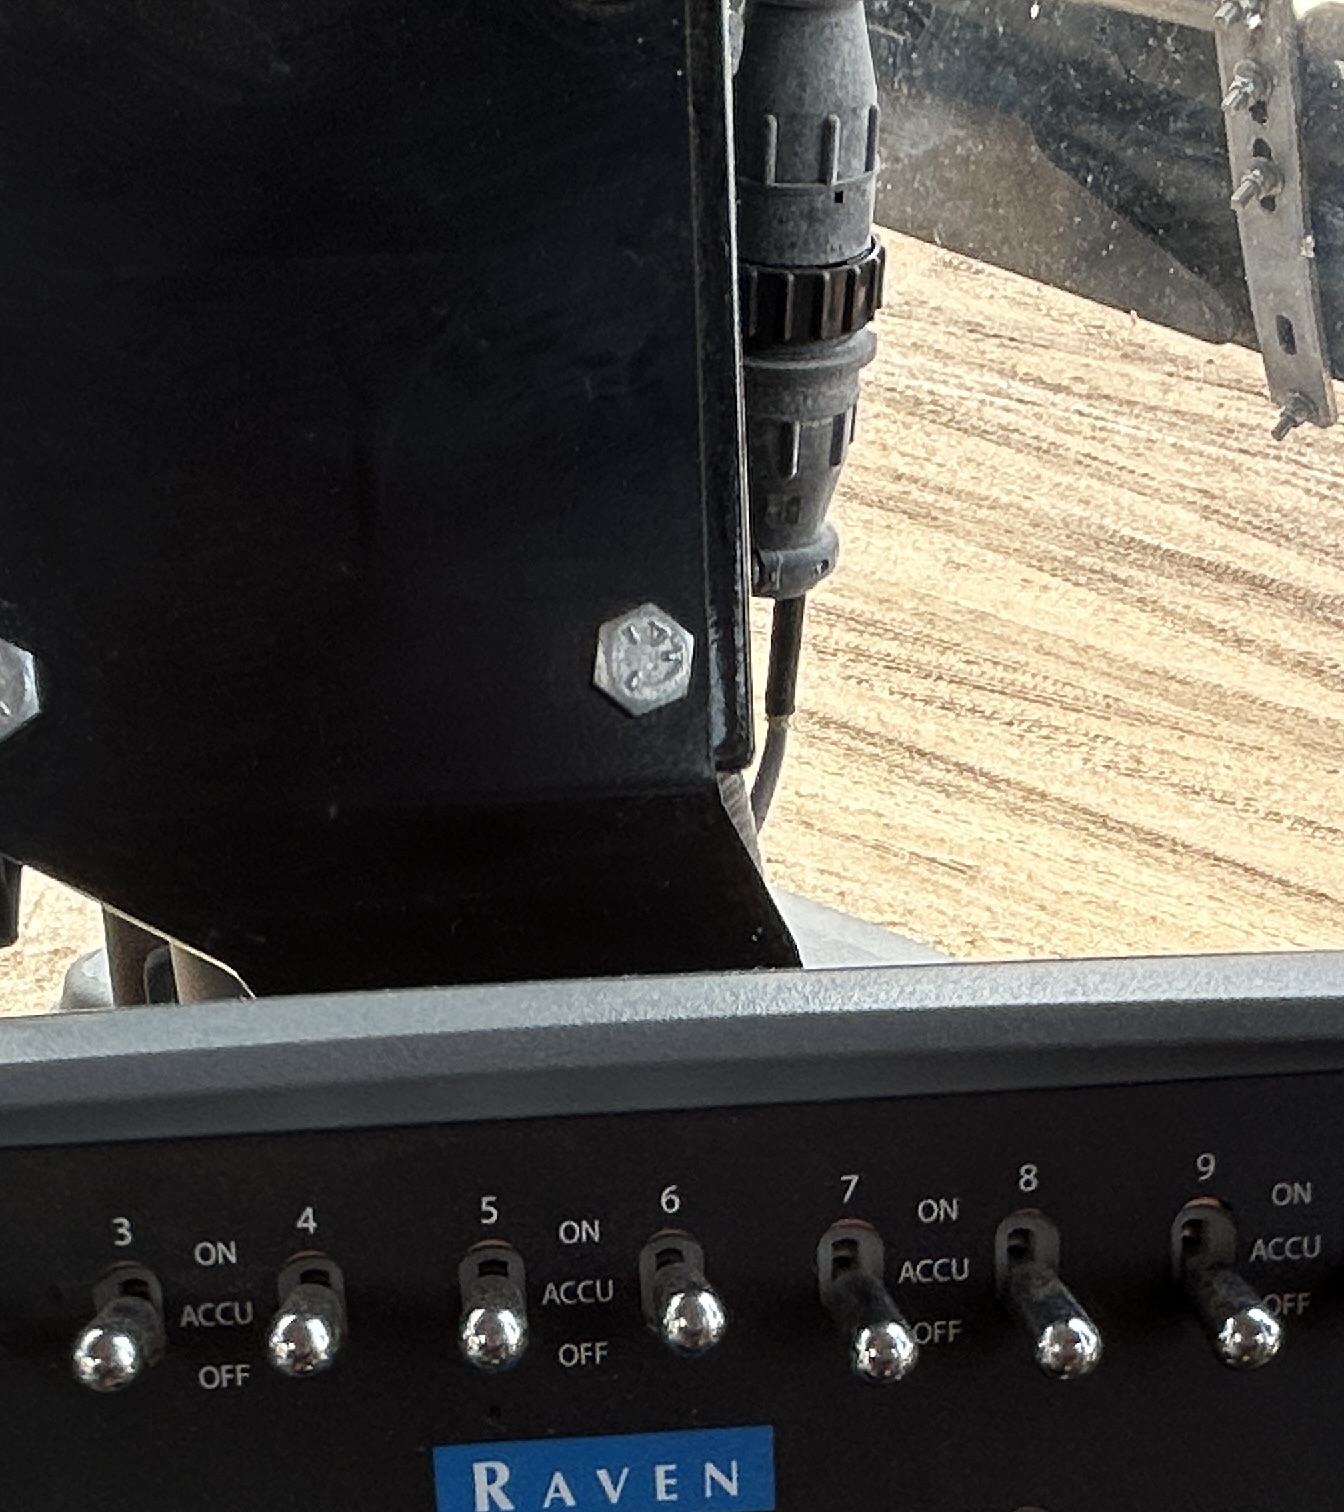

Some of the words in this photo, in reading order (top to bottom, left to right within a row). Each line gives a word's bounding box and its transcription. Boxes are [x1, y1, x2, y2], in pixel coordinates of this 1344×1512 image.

[1019, 1163, 1038, 1191] 8
[1196, 1153, 1215, 1181] 9
[660, 1185, 680, 1214] 6
[840, 1175, 859, 1203] 7
[1272, 1182, 1312, 1206] ON
[297, 1207, 317, 1234] 4
[480, 1196, 498, 1224] 5
[918, 1198, 958, 1223] ON
[112, 1217, 132, 1246] 3
[559, 1220, 600, 1244] ON
[194, 1241, 236, 1266] ON
[1250, 1235, 1321, 1262] ACCU
[899, 1258, 969, 1284] ACCU
[542, 1280, 614, 1305] ACCU
[1263, 1292, 1312, 1316] OFF
[181, 1301, 253, 1328] ACCU
[914, 1320, 963, 1345] OFF
[559, 1341, 608, 1366] OFF
[199, 1364, 251, 1389] OFF
